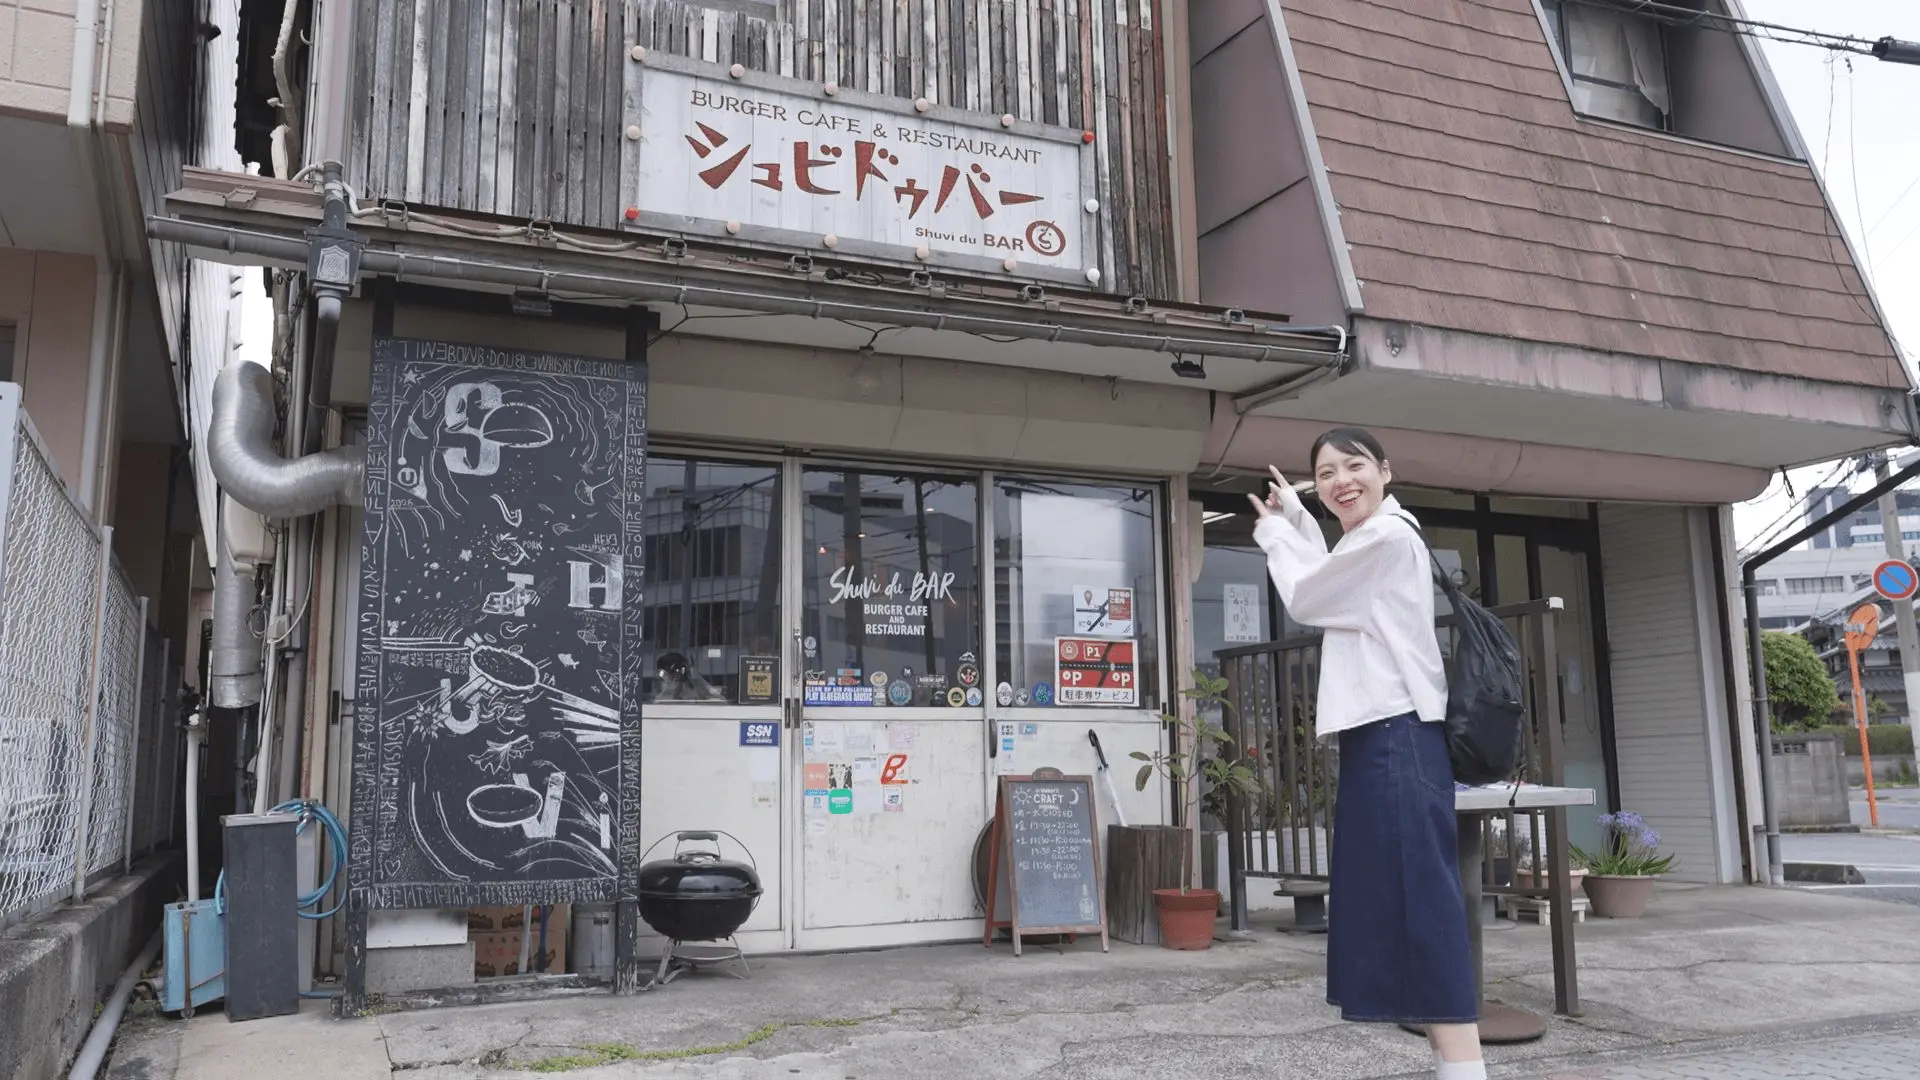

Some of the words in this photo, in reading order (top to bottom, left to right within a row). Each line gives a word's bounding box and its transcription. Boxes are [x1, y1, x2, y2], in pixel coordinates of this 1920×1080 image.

[691, 90, 787, 122] BURGER
[797, 110, 861, 134] CAFE
[872, 122, 888, 138] &
[897, 126, 1041, 165] RESTAURANT
[685, 121, 1045, 220] シュビドゥバー
[915, 227, 955, 242] Shuvi
[960, 234, 977, 245] du
[983, 233, 1024, 252] BAR
[829, 565, 881, 604] Shuvi
[884, 572, 905, 600] du
[909, 571, 957, 605] BAR
[864, 604, 903, 616] BURGER
[904, 605, 928, 616] CAFE
[889, 615, 905, 624] AND
[865, 624, 926, 636] RESTAURANT
[1064, 690, 1129, 700] 駐車券サービス
[746, 724, 773, 737] SSN
[1033, 794, 1064, 804] CRAFT
